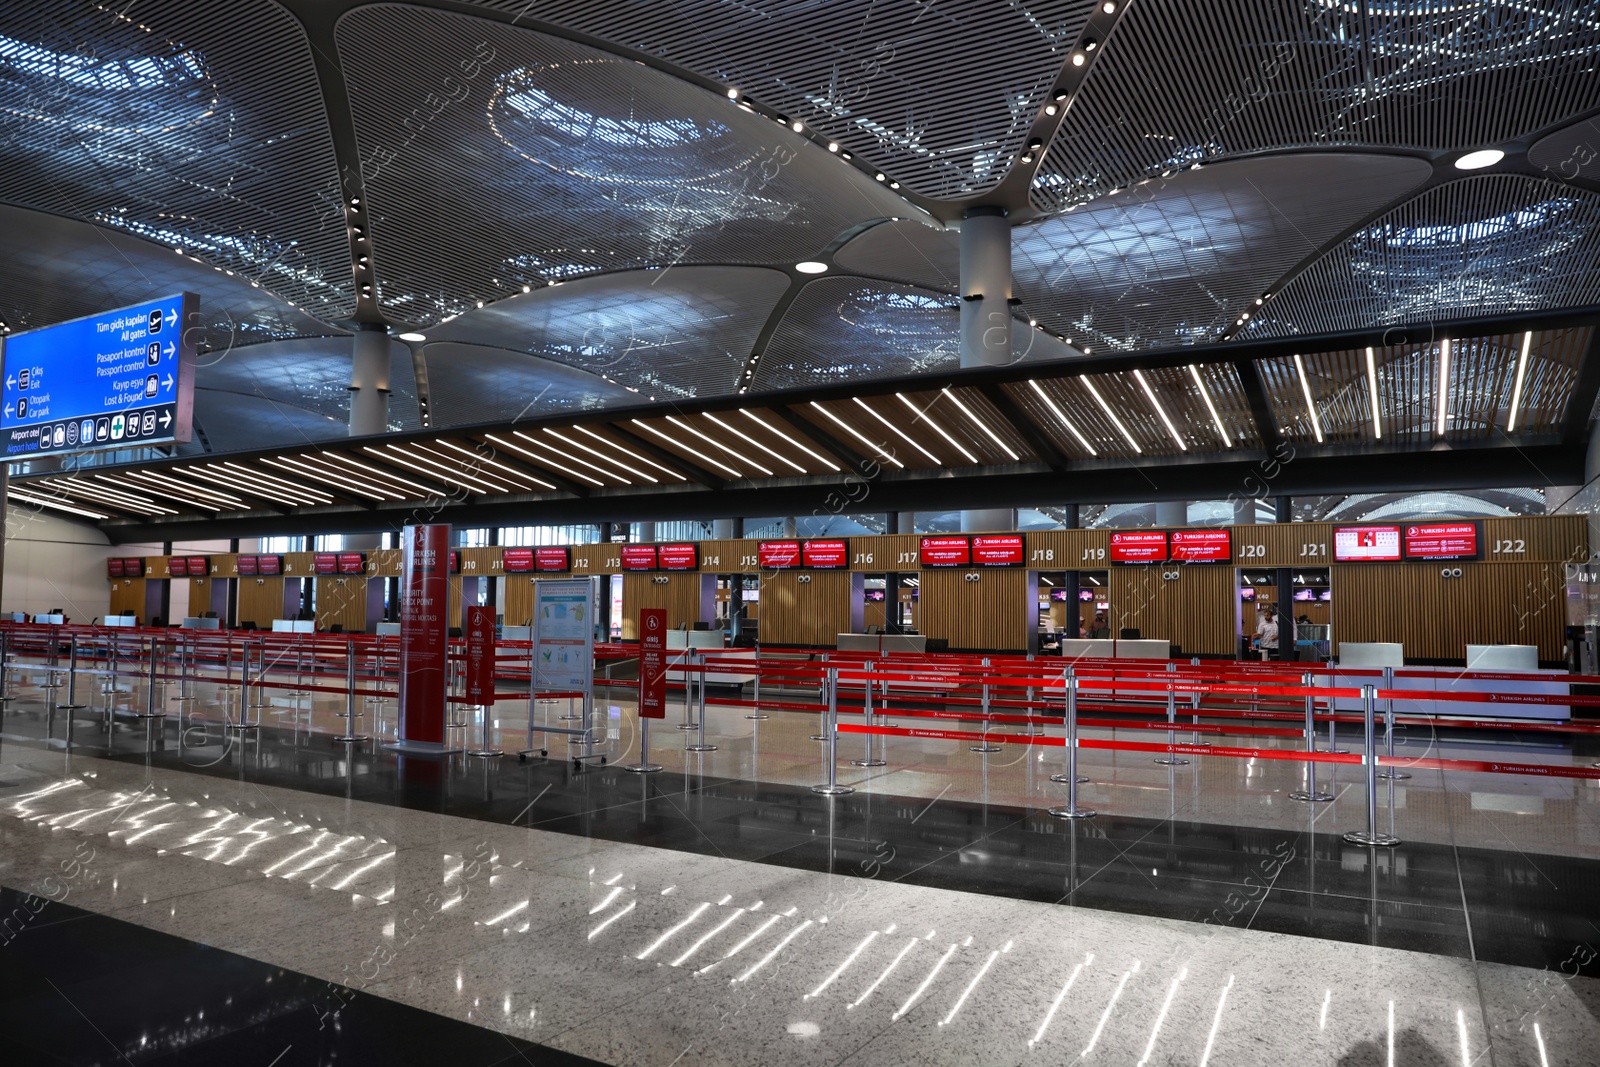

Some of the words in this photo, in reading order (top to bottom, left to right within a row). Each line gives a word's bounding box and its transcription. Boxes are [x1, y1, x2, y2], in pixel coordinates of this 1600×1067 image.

[96, 322, 110, 333] Tüm
[110, 318, 125, 332] gidiş
[125, 313, 148, 328] kapıları
[121, 332, 130, 342] All
[130, 328, 147, 343] gates
[96, 351, 124, 364] Pasaport
[124, 344, 146, 360] kontrol
[31, 366, 43, 377] Çıkış
[96, 365, 122, 378] Passport
[123, 359, 145, 373] control
[30, 380, 40, 389] Exit
[113, 380, 129, 393] Kayıp
[130, 377, 144, 391] eşya
[30, 393, 50, 406] Otopark
[104, 395, 117, 406] Lost
[118, 394, 123, 404] &
[123, 391, 143, 403] Found
[29, 408, 38, 418] Car
[38, 407, 50, 418] park
[11, 428, 29, 441] Airport
[29, 427, 40, 438] otel
[7, 441, 26, 454] Airport
[26, 440, 39, 451] hotel
[1238, 544, 1266, 558] J20
[1300, 544, 1326, 556] J21
[1492, 540, 1526, 554] J22
[854, 553, 874, 564] J16
[898, 552, 918, 564] J17
[1031, 549, 1054, 561] J18
[1082, 548, 1106, 560] J19
[368, 562, 376, 570] J8
[463, 560, 476, 570] J10
[491, 560, 504, 569] J11
[574, 558, 589, 568] J12
[605, 558, 621, 568] J13
[702, 556, 720, 566] J14
[740, 555, 758, 566] J15
[211, 565, 218, 573] J4
[285, 564, 292, 572] J6
